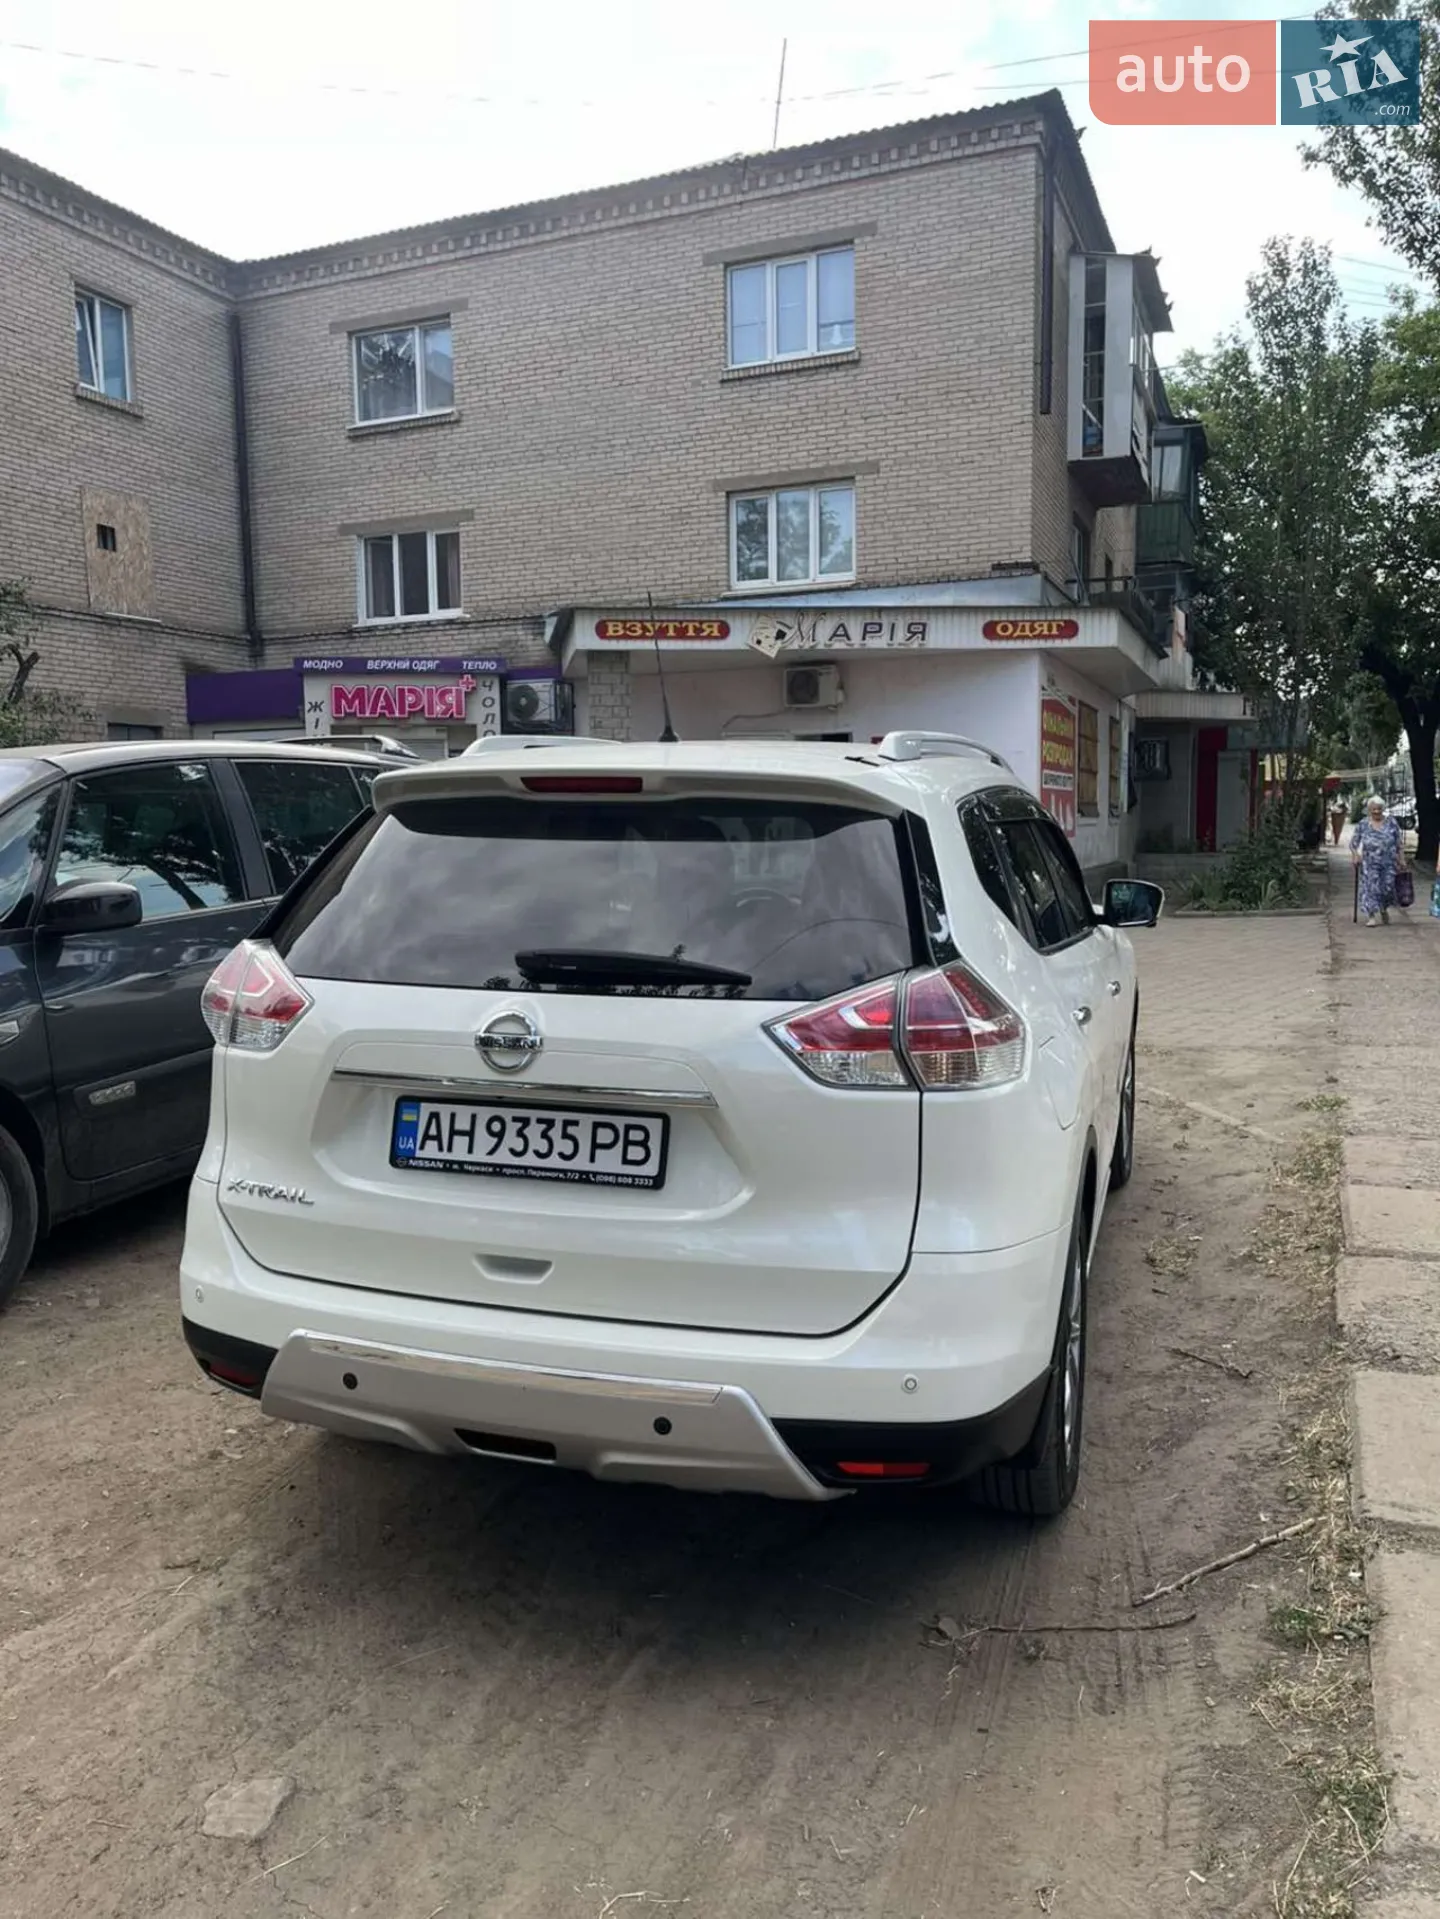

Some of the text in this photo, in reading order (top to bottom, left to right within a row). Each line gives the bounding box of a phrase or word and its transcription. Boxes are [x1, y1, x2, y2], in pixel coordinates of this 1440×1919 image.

[605, 621, 721, 636] ВЗУТТЯ
[995, 621, 1065, 637] ОДЯГ
[303, 659, 344, 670] МОДНО
[366, 659, 440, 671] ВЕРХНІЙ ОДЯГ
[462, 660, 497, 671] ТЕПЛО
[400, 1135, 415, 1150] UA
[227, 1178, 316, 1207] X-TRAIL
